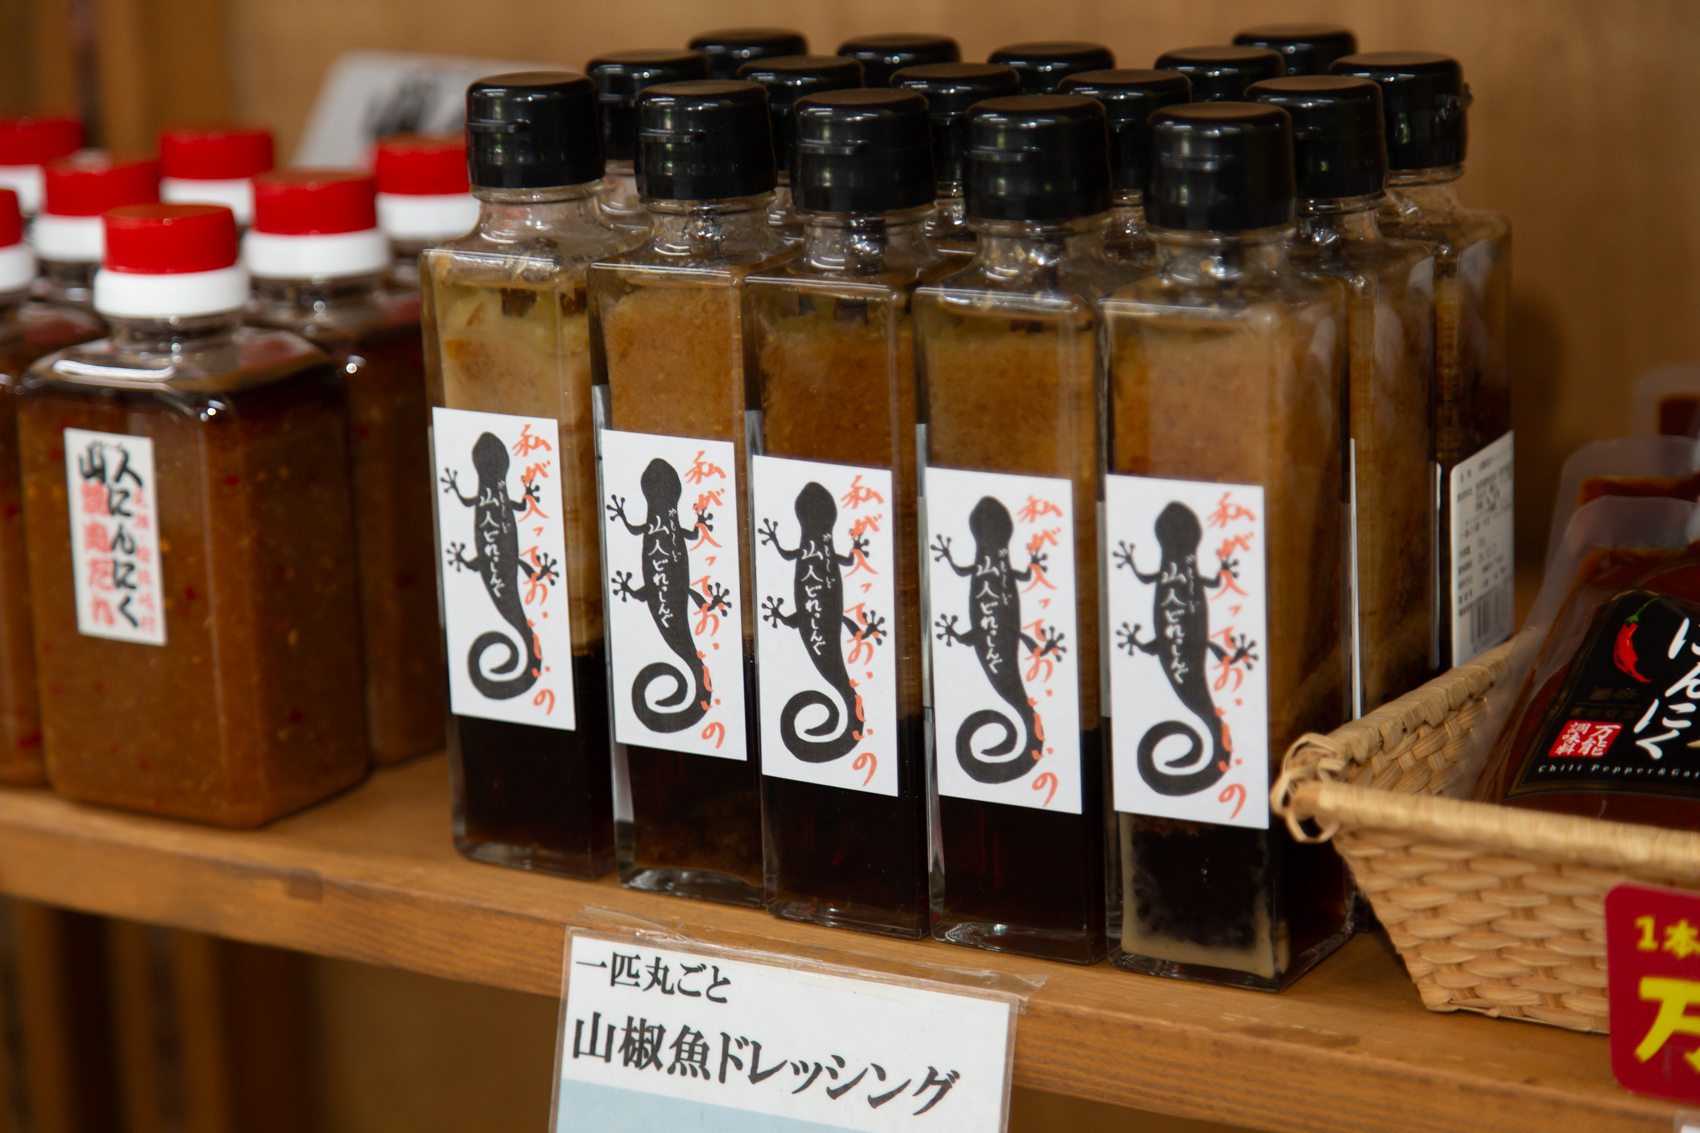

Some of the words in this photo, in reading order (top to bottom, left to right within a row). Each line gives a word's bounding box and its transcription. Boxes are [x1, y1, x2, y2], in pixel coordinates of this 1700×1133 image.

[513, 424, 555, 715] 私が入っておいしいの
[685, 451, 726, 749] 私が入っておいしいの
[842, 475, 884, 786] 私が入っておいしいの
[1018, 495, 1063, 807] 私が入っておいしいの
[1209, 492, 1256, 820] 私が入っておいしいの
[572, 1011, 961, 1116] 山椒魚ドレッシング
[575, 951, 732, 1004] 一匹丸ごと
